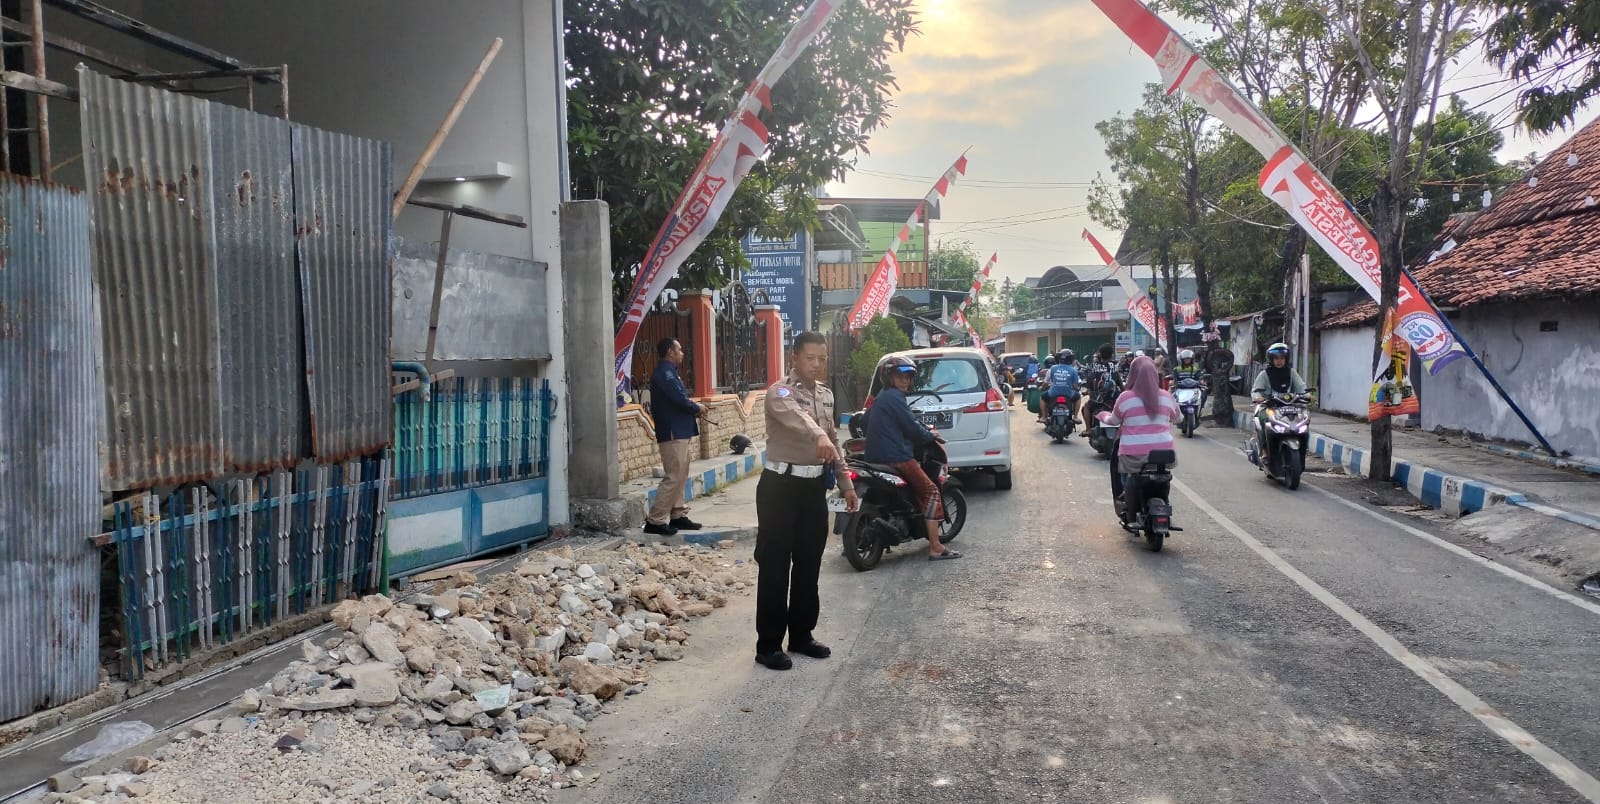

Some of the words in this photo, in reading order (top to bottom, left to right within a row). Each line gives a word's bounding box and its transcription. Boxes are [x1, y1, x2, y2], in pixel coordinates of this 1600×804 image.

[759, 256, 782, 267] PERKASA
[783, 255, 801, 266] MOTOR
[775, 277, 795, 285] MOBIL
[769, 286, 786, 294] PART
